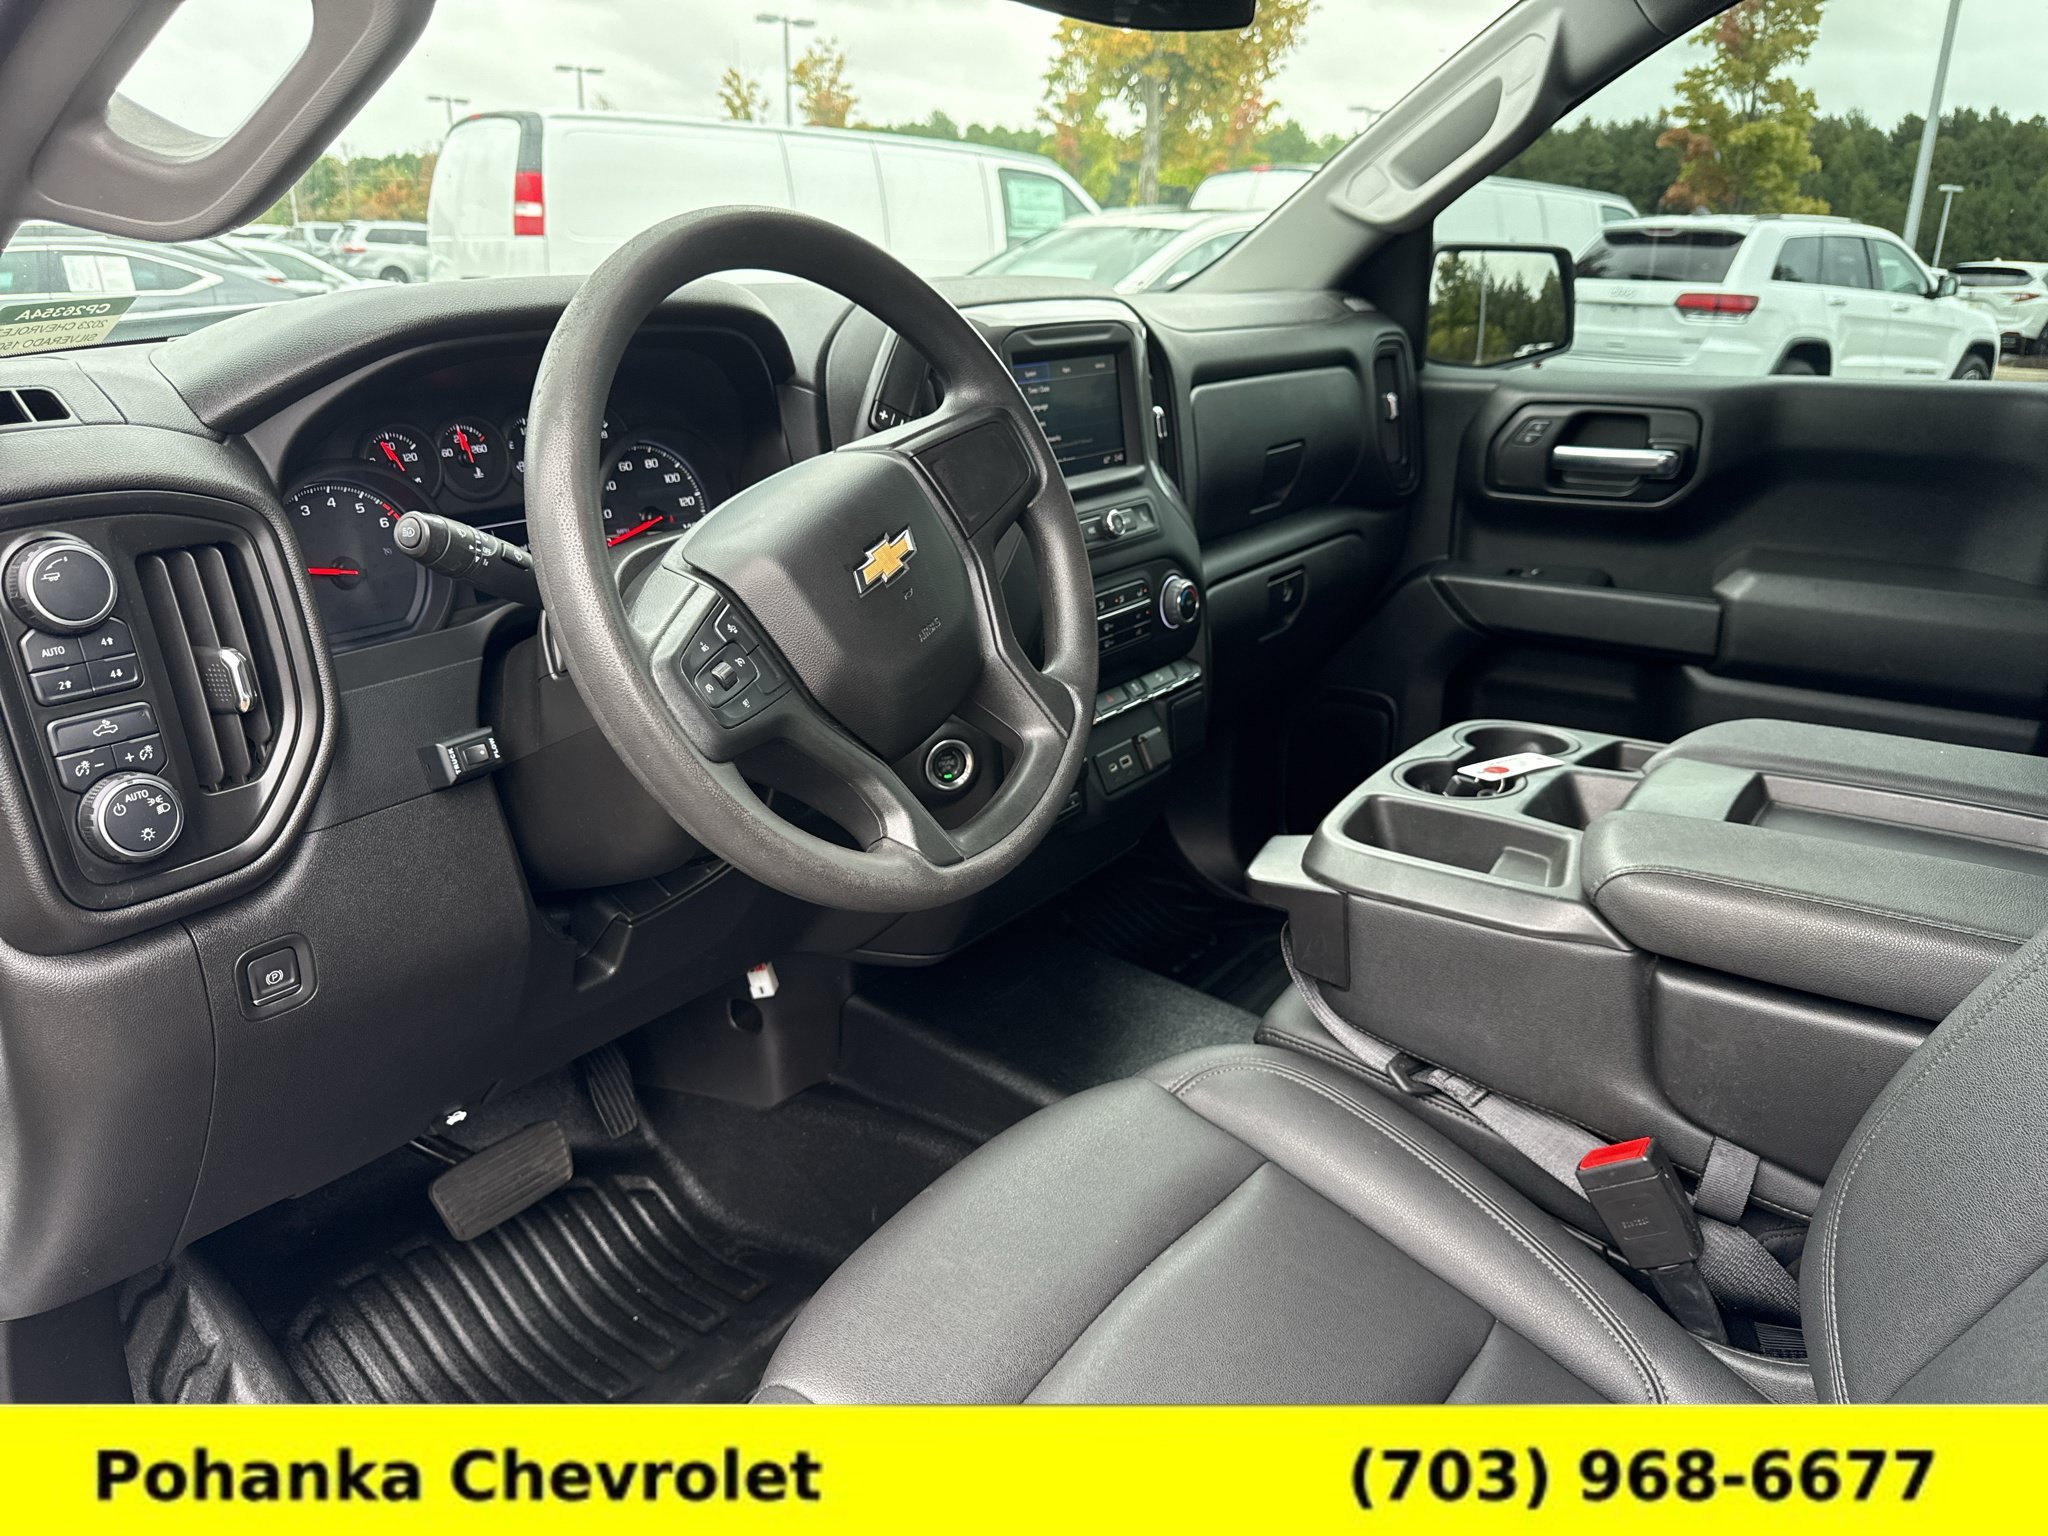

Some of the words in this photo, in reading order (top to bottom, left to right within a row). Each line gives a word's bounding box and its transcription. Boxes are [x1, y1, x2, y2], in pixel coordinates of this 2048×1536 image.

[402, 452, 418, 462] 120
[618, 461, 633, 472] 60
[644, 458, 659, 469] 80
[664, 473, 681, 484] 100
[326, 497, 337, 508] 4
[679, 496, 695, 507] 120
[300, 505, 311, 517] 3
[354, 502, 366, 514] 5
[379, 517, 390, 529] 6
[41, 645, 66, 659] AUTO
[125, 789, 149, 803] AUTO
